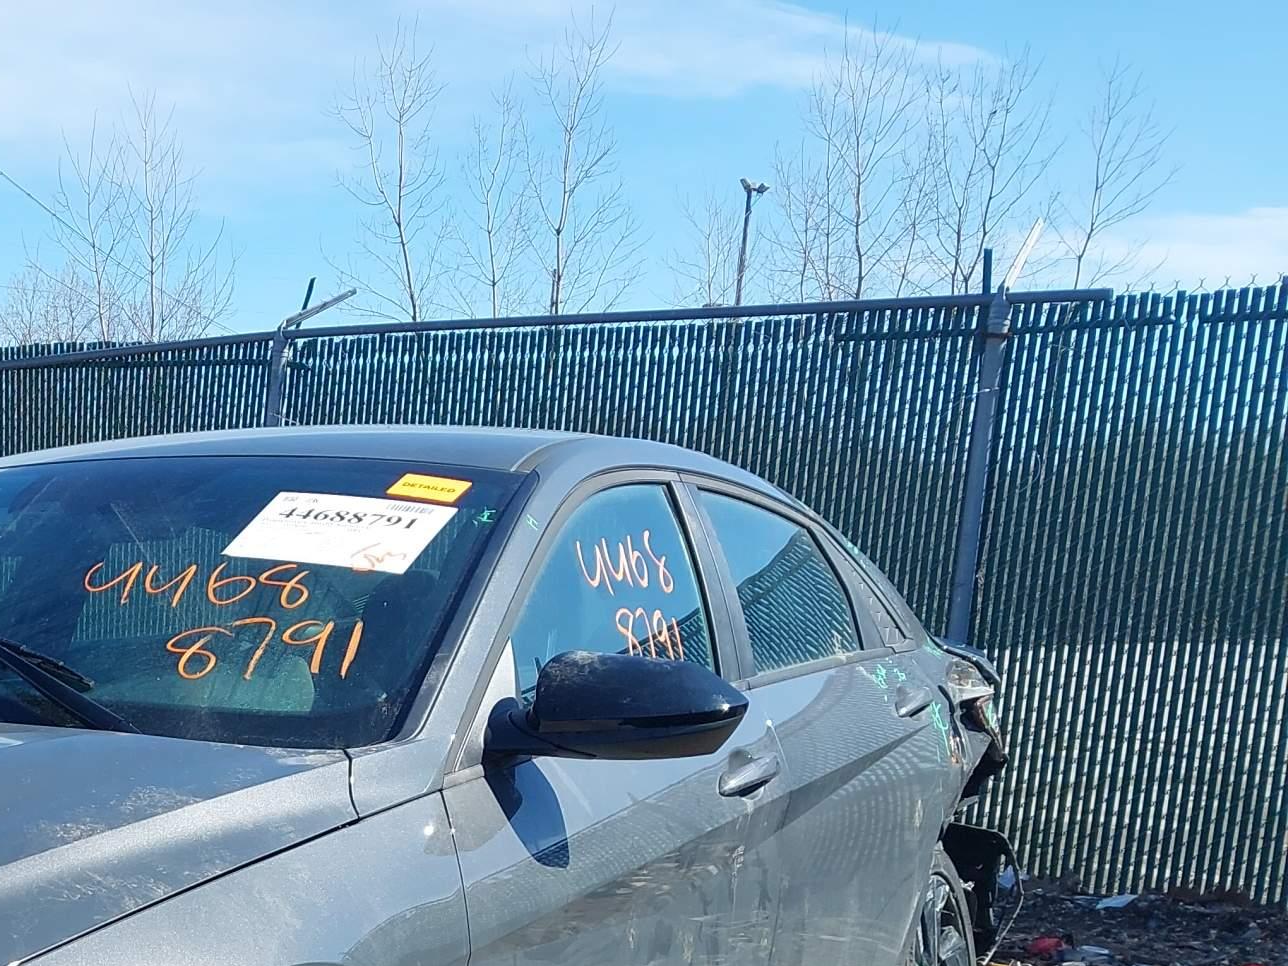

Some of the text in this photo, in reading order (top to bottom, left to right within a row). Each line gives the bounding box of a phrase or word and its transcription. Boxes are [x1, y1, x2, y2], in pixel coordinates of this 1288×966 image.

[402, 481, 457, 493] DETAILED
[279, 506, 419, 530] 44688791
[84, 561, 311, 609] 4468
[573, 530, 674, 596] 4468
[165, 616, 364, 680] 8791
[615, 607, 685, 661] 8791
